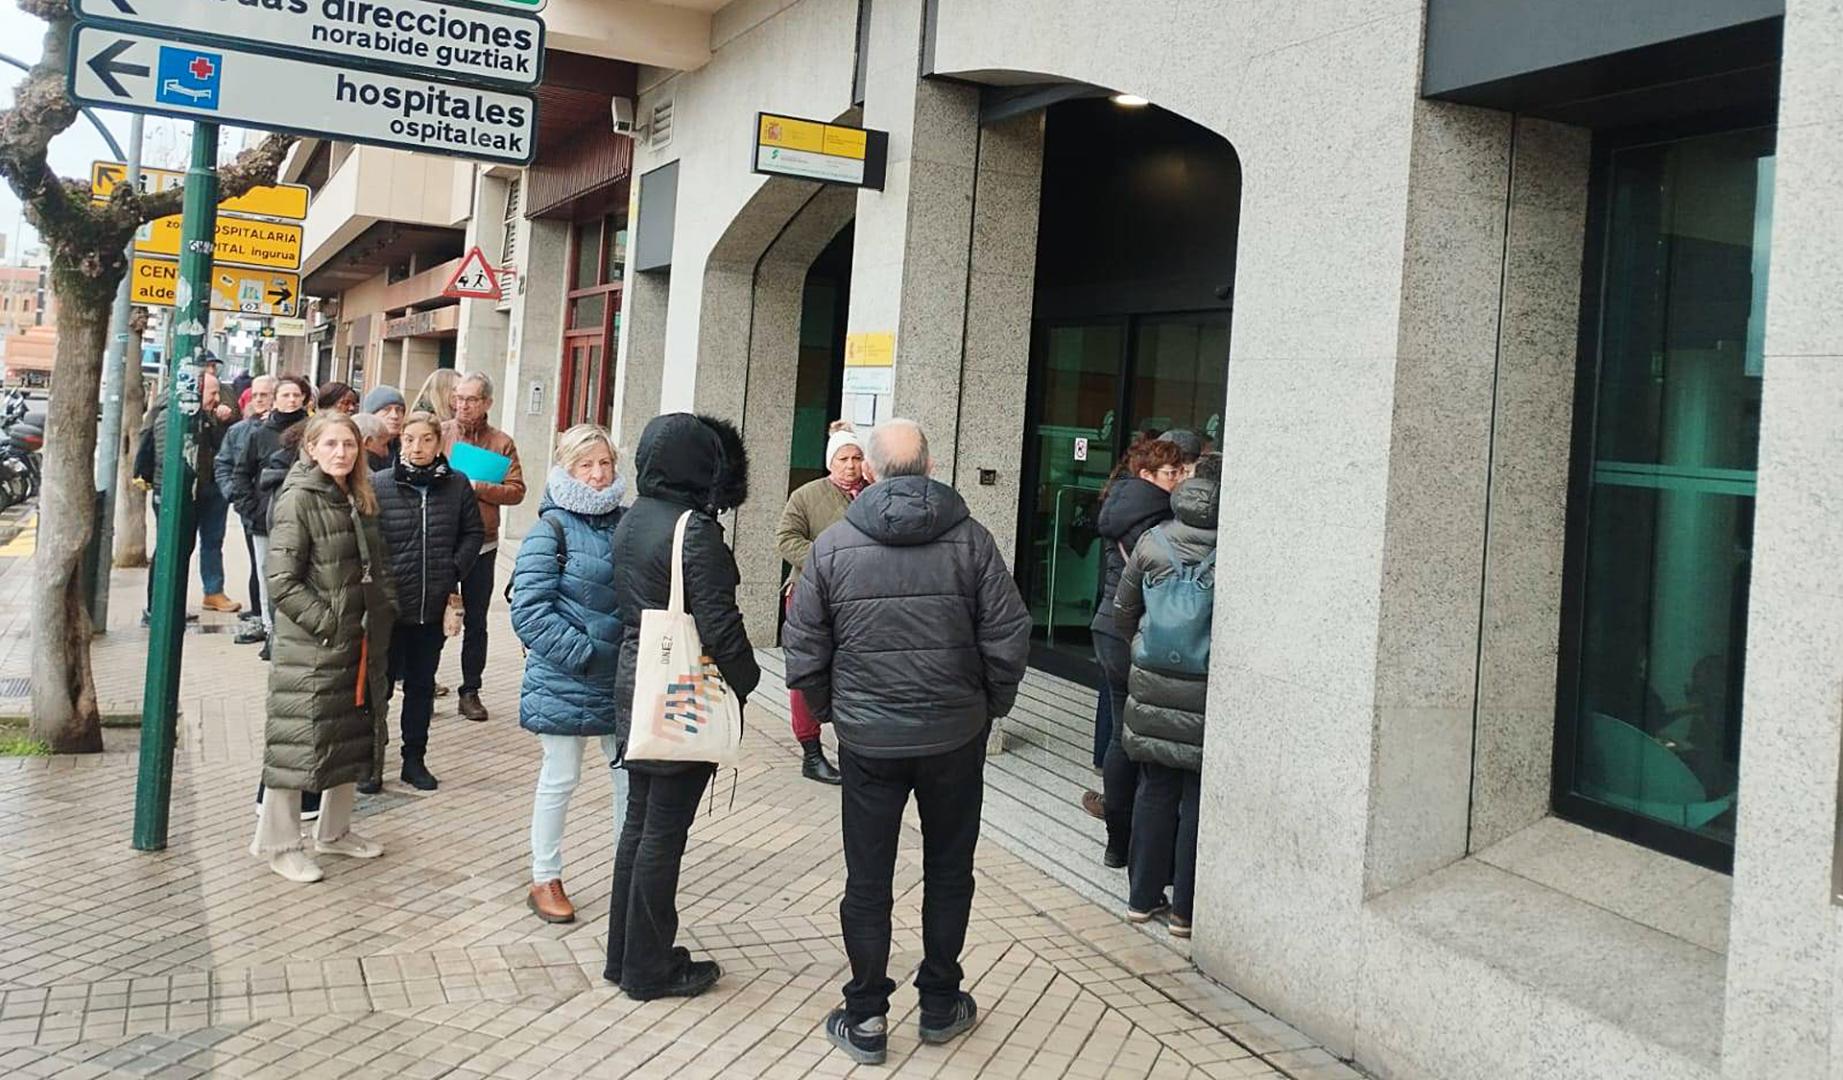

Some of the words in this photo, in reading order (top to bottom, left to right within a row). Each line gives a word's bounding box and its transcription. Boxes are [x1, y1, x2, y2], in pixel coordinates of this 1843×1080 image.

[322, 0, 533, 50] direcciones
[311, 24, 429, 57] norabide
[436, 44, 529, 73] guztiak
[336, 73, 525, 128] hospitales
[390, 119, 522, 152] ospitaleak
[166, 220, 181, 229] zo
[215, 225, 297, 243] OSPITALARIA
[251, 246, 295, 260] ingurua
[140, 264, 177, 279] CEN
